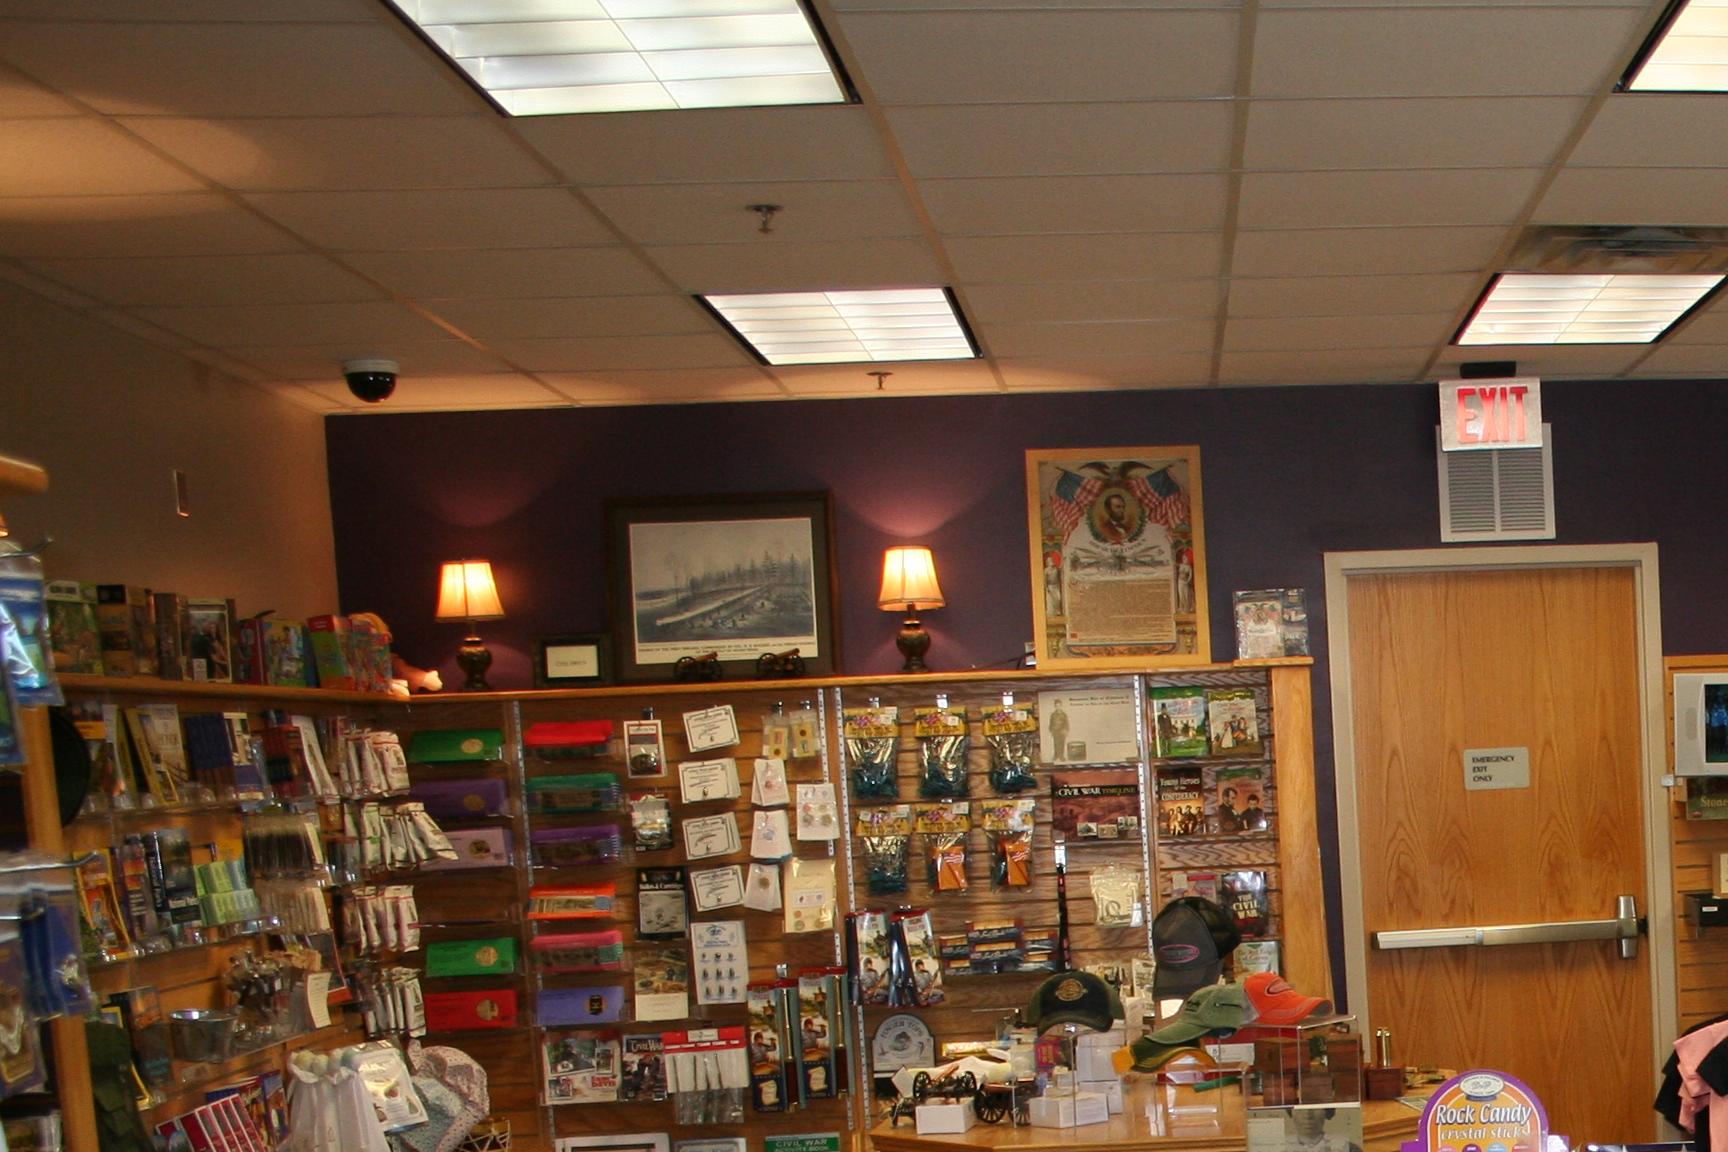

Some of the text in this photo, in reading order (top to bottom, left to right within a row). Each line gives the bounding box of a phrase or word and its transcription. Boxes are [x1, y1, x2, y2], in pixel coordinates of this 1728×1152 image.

[1456, 386, 1528, 444] EXIT
[1472, 755, 1515, 763] EMERGENCY
[1058, 788, 1079, 797] CIVIL
[1436, 1104, 1532, 1126] Rock Candy
[1441, 1128, 1486, 1139] crystal
